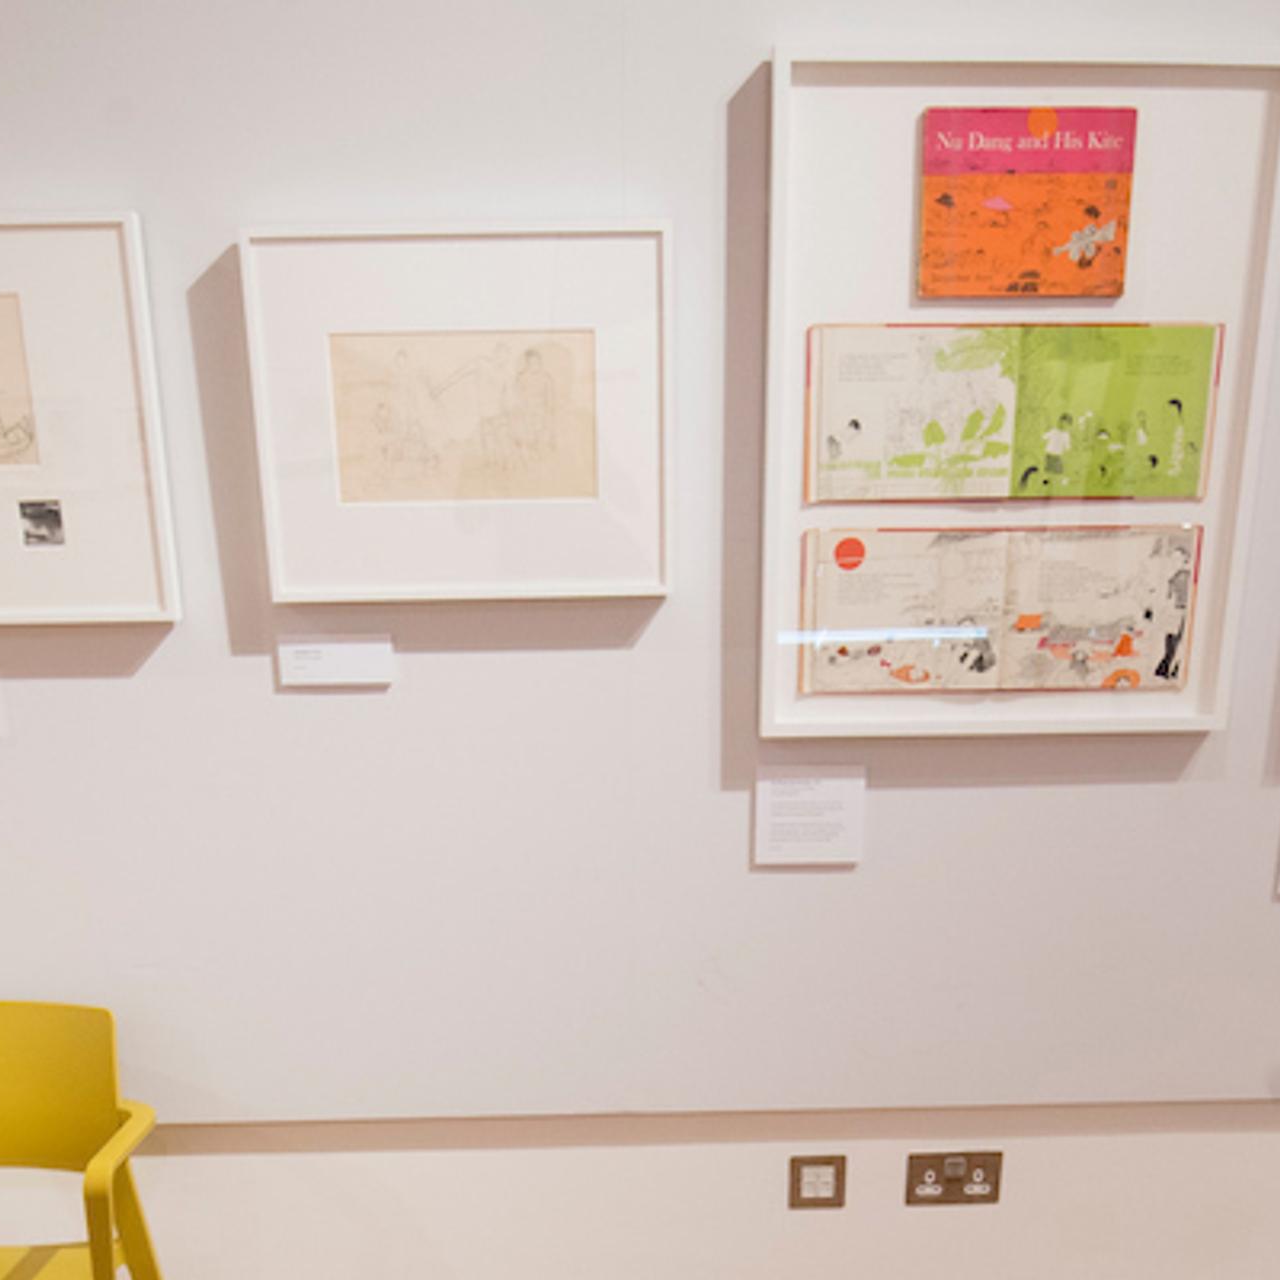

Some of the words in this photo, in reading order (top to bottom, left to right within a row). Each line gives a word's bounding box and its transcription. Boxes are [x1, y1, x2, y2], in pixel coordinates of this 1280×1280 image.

[969, 131, 1013, 152] Dang
[1017, 131, 1048, 149] and
[1054, 131, 1082, 149] His
[1087, 131, 1125, 149] Kite
